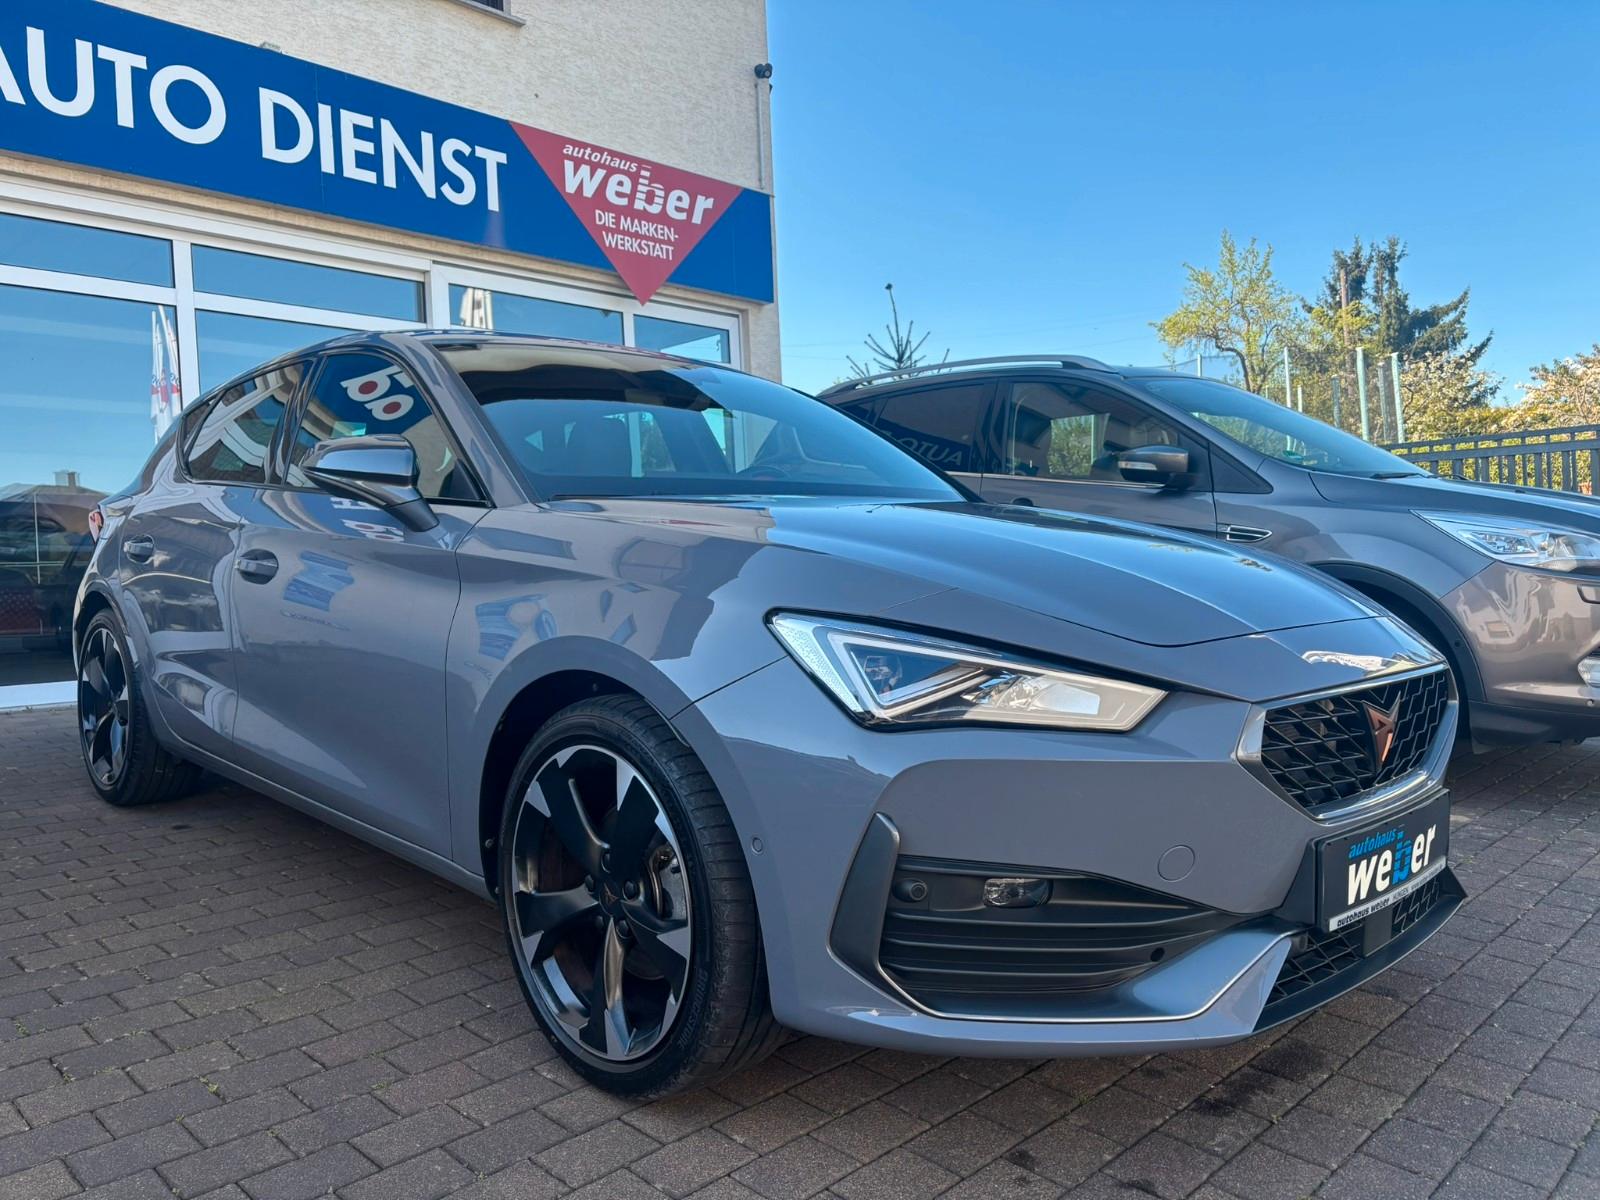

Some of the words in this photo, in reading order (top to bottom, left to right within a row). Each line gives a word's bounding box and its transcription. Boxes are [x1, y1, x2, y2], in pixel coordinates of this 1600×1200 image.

[258, 86, 508, 212] DIENST
[562, 143, 638, 172] autohaus
[563, 159, 715, 225] weber
[594, 208, 617, 230] DIE
[619, 214, 679, 242] MARKEN-
[602, 230, 675, 261] WERKSTATT
[1348, 828, 1396, 859] autohaus
[1347, 823, 1437, 906] weber
[1336, 906, 1370, 927] autohaus
